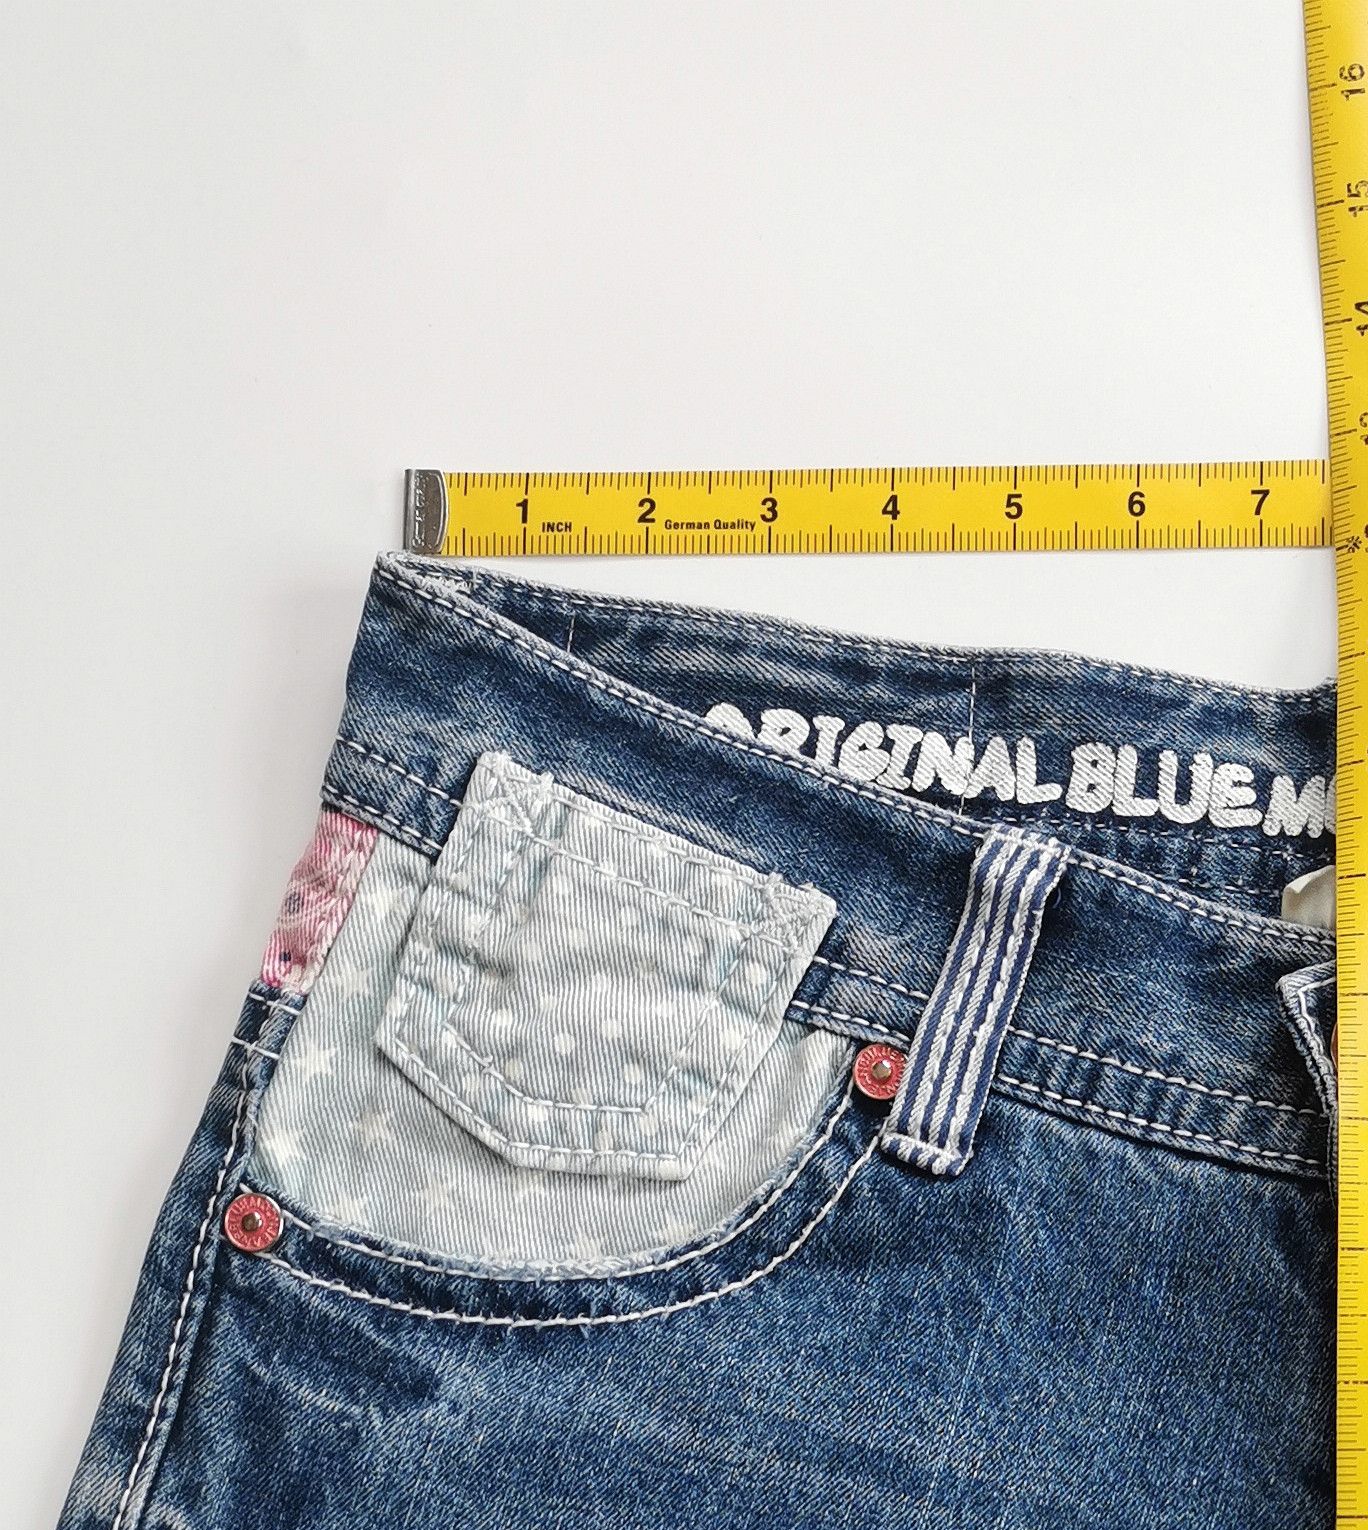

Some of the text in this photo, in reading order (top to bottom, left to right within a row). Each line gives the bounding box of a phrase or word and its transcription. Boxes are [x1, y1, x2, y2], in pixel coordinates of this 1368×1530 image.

[1339, 63, 1366, 101] 16
[515, 498, 529, 524] 1
[637, 497, 656, 524] 2
[759, 497, 778, 523] 3
[881, 494, 901, 521] 4
[1004, 493, 1023, 520] 5
[1127, 491, 1146, 518] 6
[1250, 488, 1270, 516] 7
[542, 521, 572, 533] INCH
[664, 518, 757, 532] German Quality
[1066, 742, 1263, 829] BLUE
